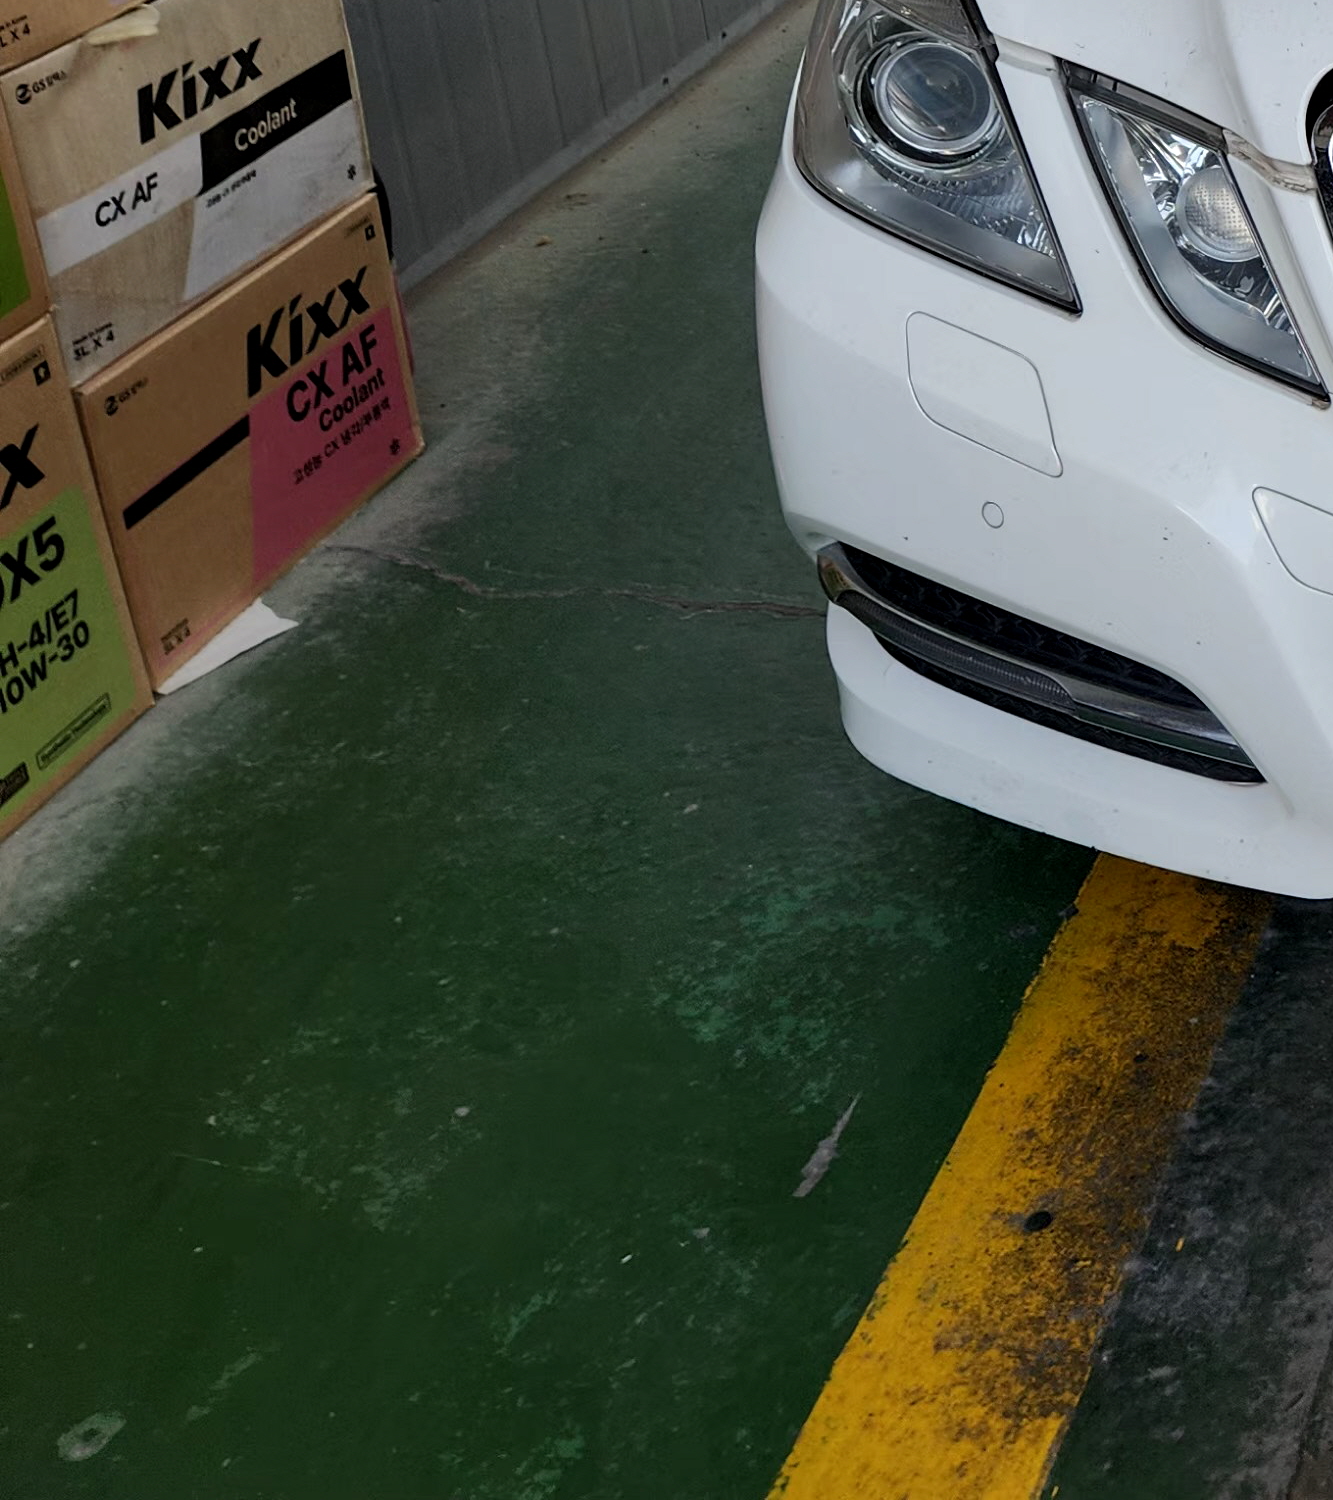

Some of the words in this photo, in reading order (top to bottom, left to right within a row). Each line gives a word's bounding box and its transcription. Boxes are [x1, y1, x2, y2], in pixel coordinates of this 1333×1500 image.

[23, 22, 31, 36] 4
[137, 37, 263, 146] Kixx
[234, 98, 298, 152] Coolant
[94, 190, 127, 228] CX
[131, 171, 159, 211] AF
[246, 265, 371, 398] Kixx
[286, 360, 336, 423] CX
[342, 323, 378, 387] AF
[319, 367, 386, 433] Coolant
